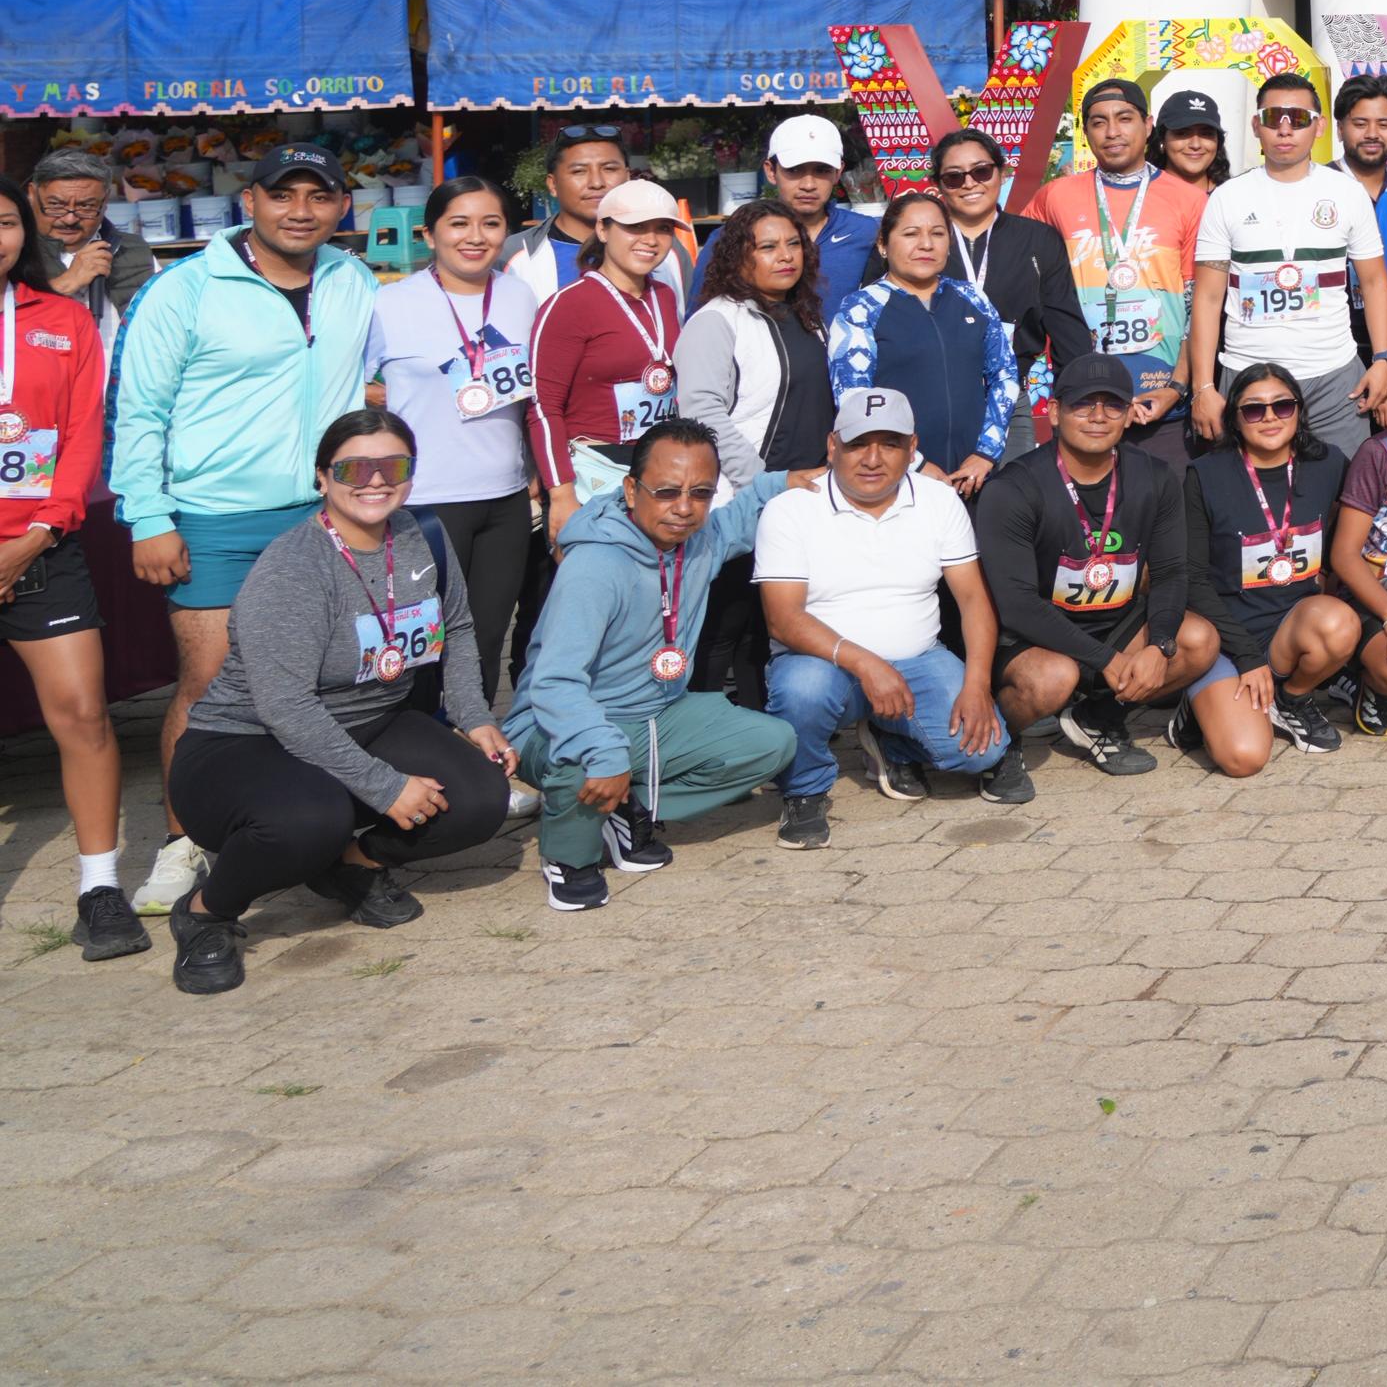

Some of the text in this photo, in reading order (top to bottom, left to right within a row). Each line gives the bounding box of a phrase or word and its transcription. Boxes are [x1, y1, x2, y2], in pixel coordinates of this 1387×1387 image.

[11, 84, 27, 102] Y
[42, 82, 100, 102] MAS
[144, 78, 248, 100] FLORERIA
[532, 71, 848, 95] FLORERIA SOCORRI
[1260, 286, 1304, 314] 195
[1099, 318, 1149, 348] 238
[866, 395, 887, 418] P
[1257, 548, 1309, 581] 25
[394, 626, 429, 665] 26
